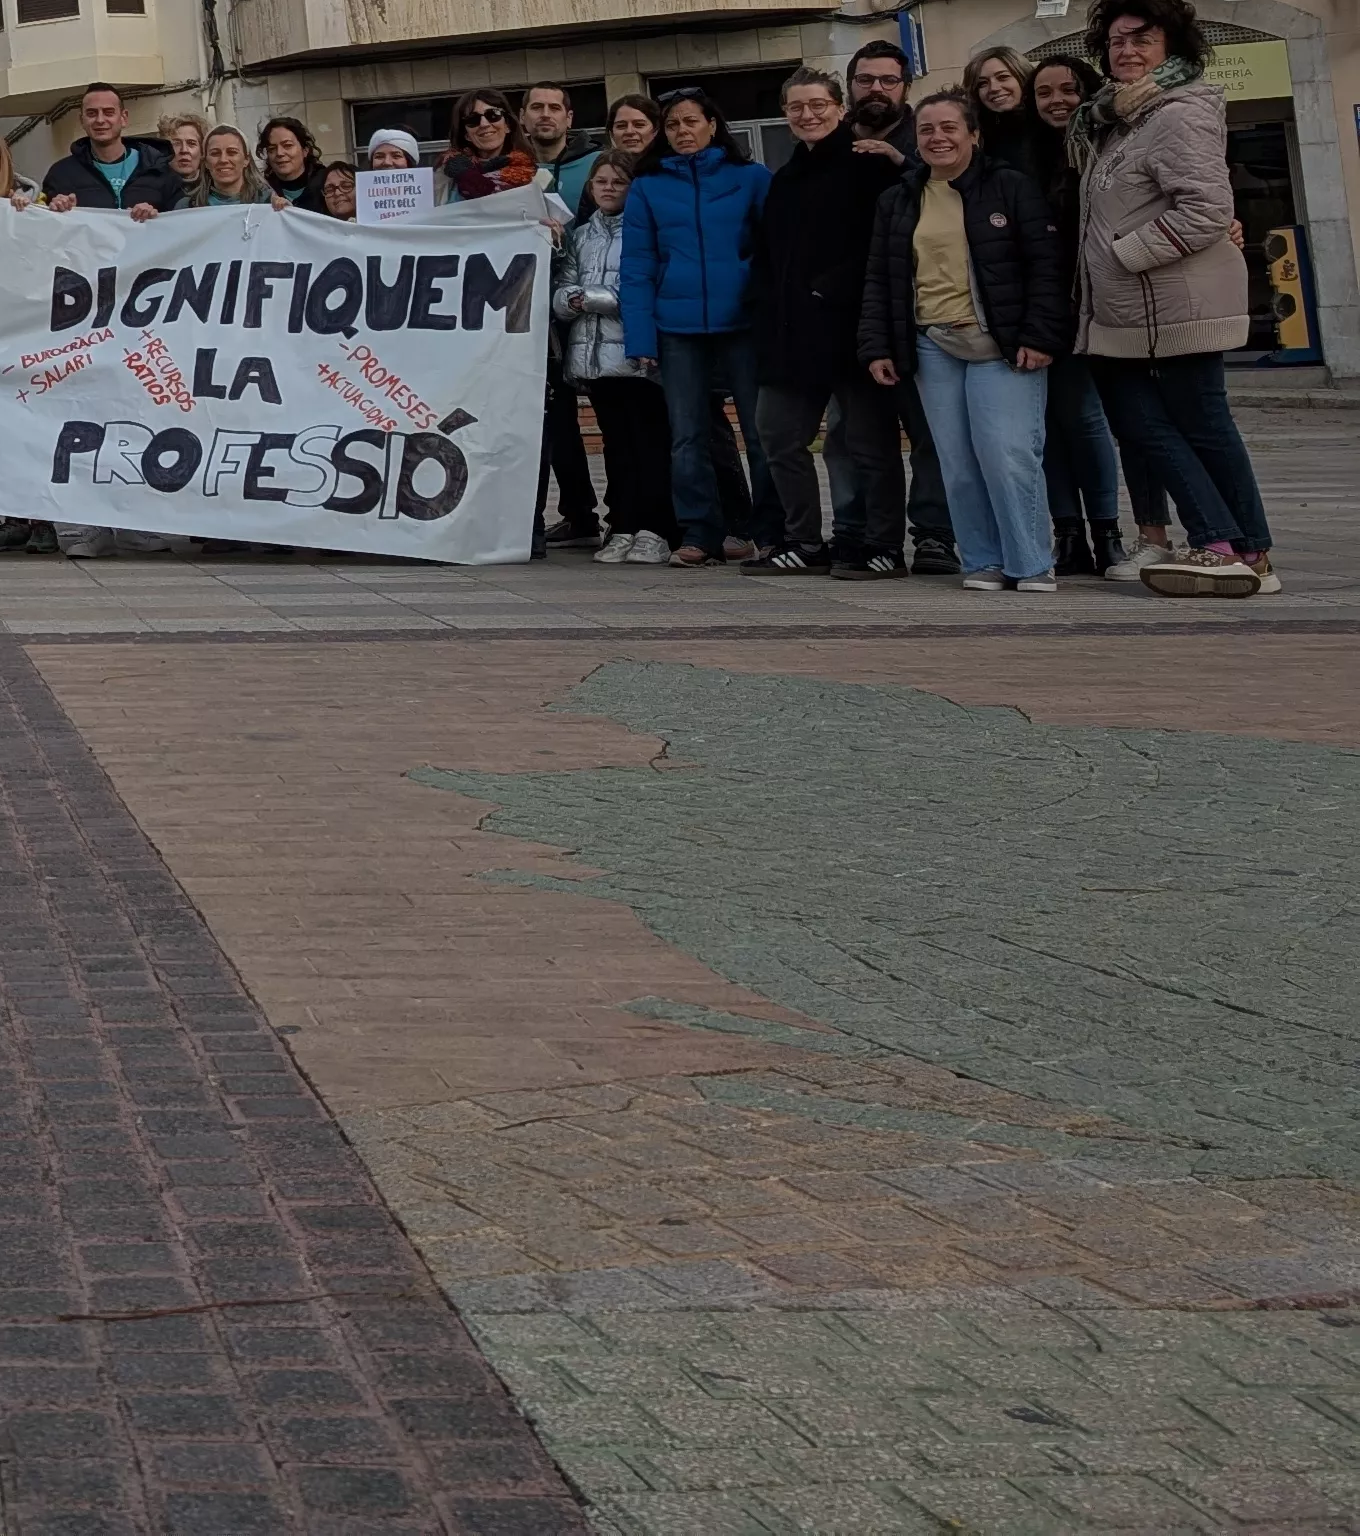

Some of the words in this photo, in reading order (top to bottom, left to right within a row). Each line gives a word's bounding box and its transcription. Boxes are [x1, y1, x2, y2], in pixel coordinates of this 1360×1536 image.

[391, 173, 414, 183] ESTEM
[50, 253, 537, 340] DIGNIFIQUEM
[30, 353, 93, 395] SALARI
[192, 347, 283, 406] LA
[51, 407, 479, 521] PROFESSIÓ
